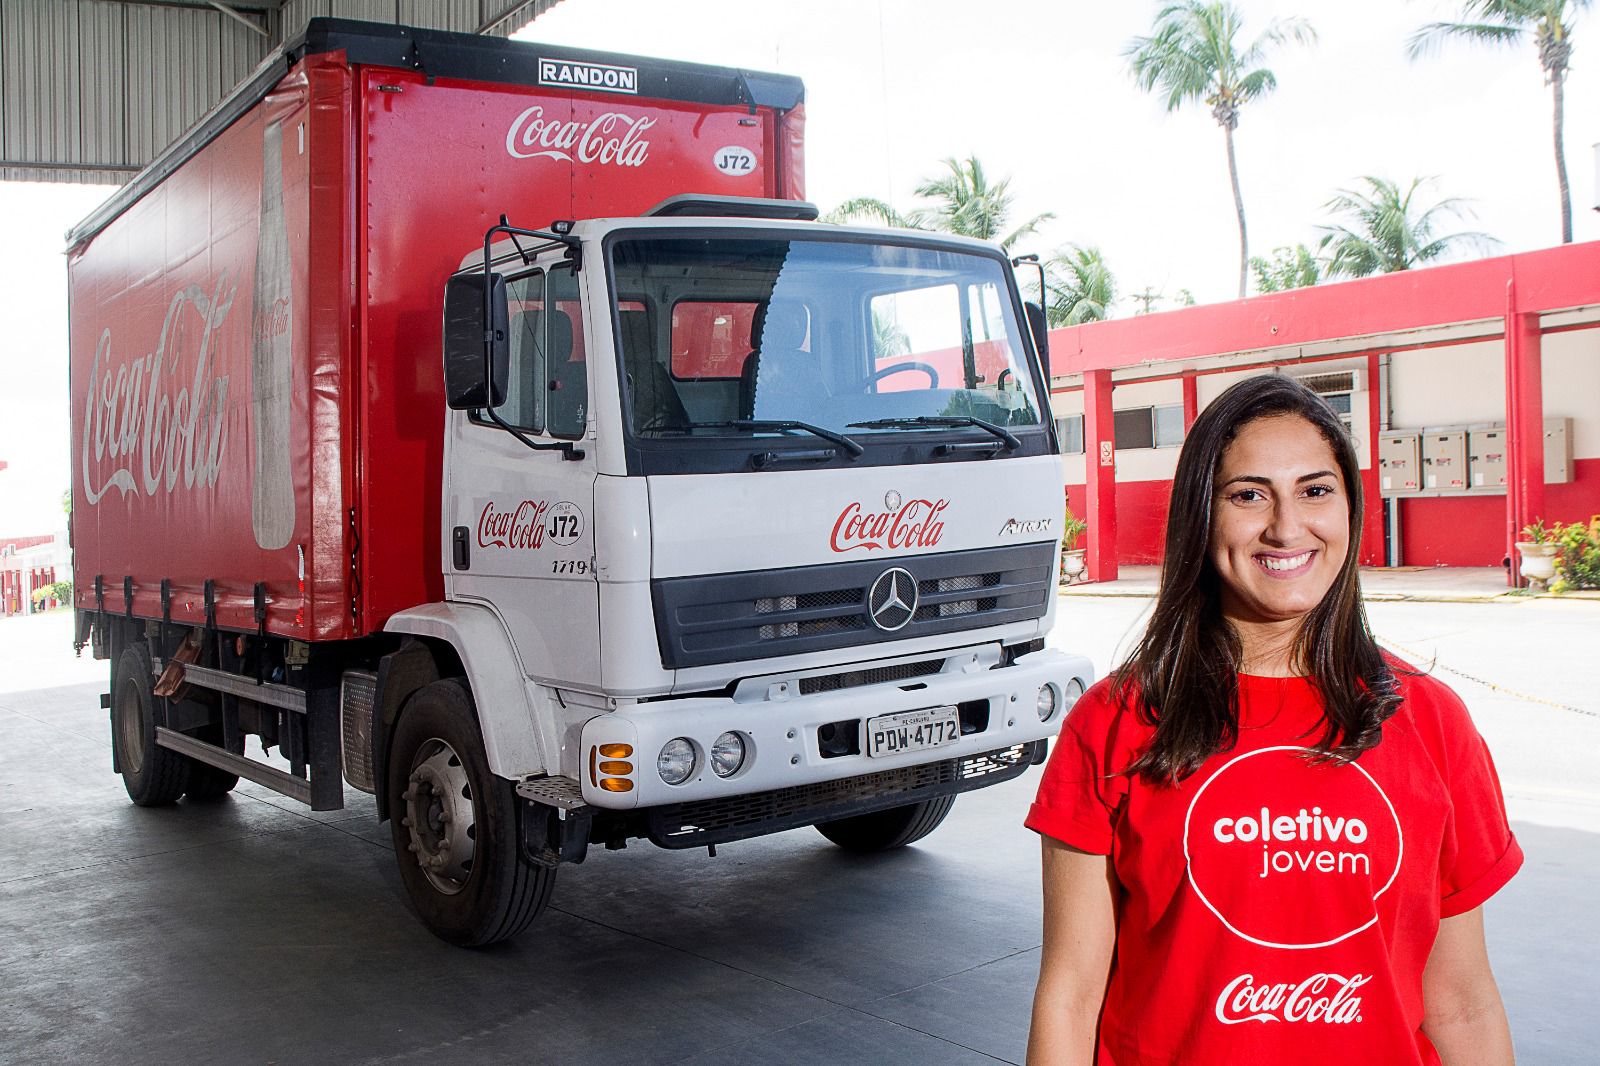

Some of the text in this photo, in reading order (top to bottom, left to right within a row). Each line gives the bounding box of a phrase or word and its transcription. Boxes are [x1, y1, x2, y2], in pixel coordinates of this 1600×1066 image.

[542, 63, 634, 89] RANDON
[506, 106, 657, 167] Coca-Cola
[719, 155, 750, 170] J72
[82, 267, 240, 506] Coca-Cola
[477, 500, 549, 550] Coca-Cola
[548, 515, 579, 538] J72
[830, 498, 950, 553] Coca-Cola
[552, 560, 587, 575] 1719
[1213, 807, 1368, 844] coletivo
[1259, 845, 1370, 878] jovem
[1215, 972, 1373, 1025] Coca-Cola
